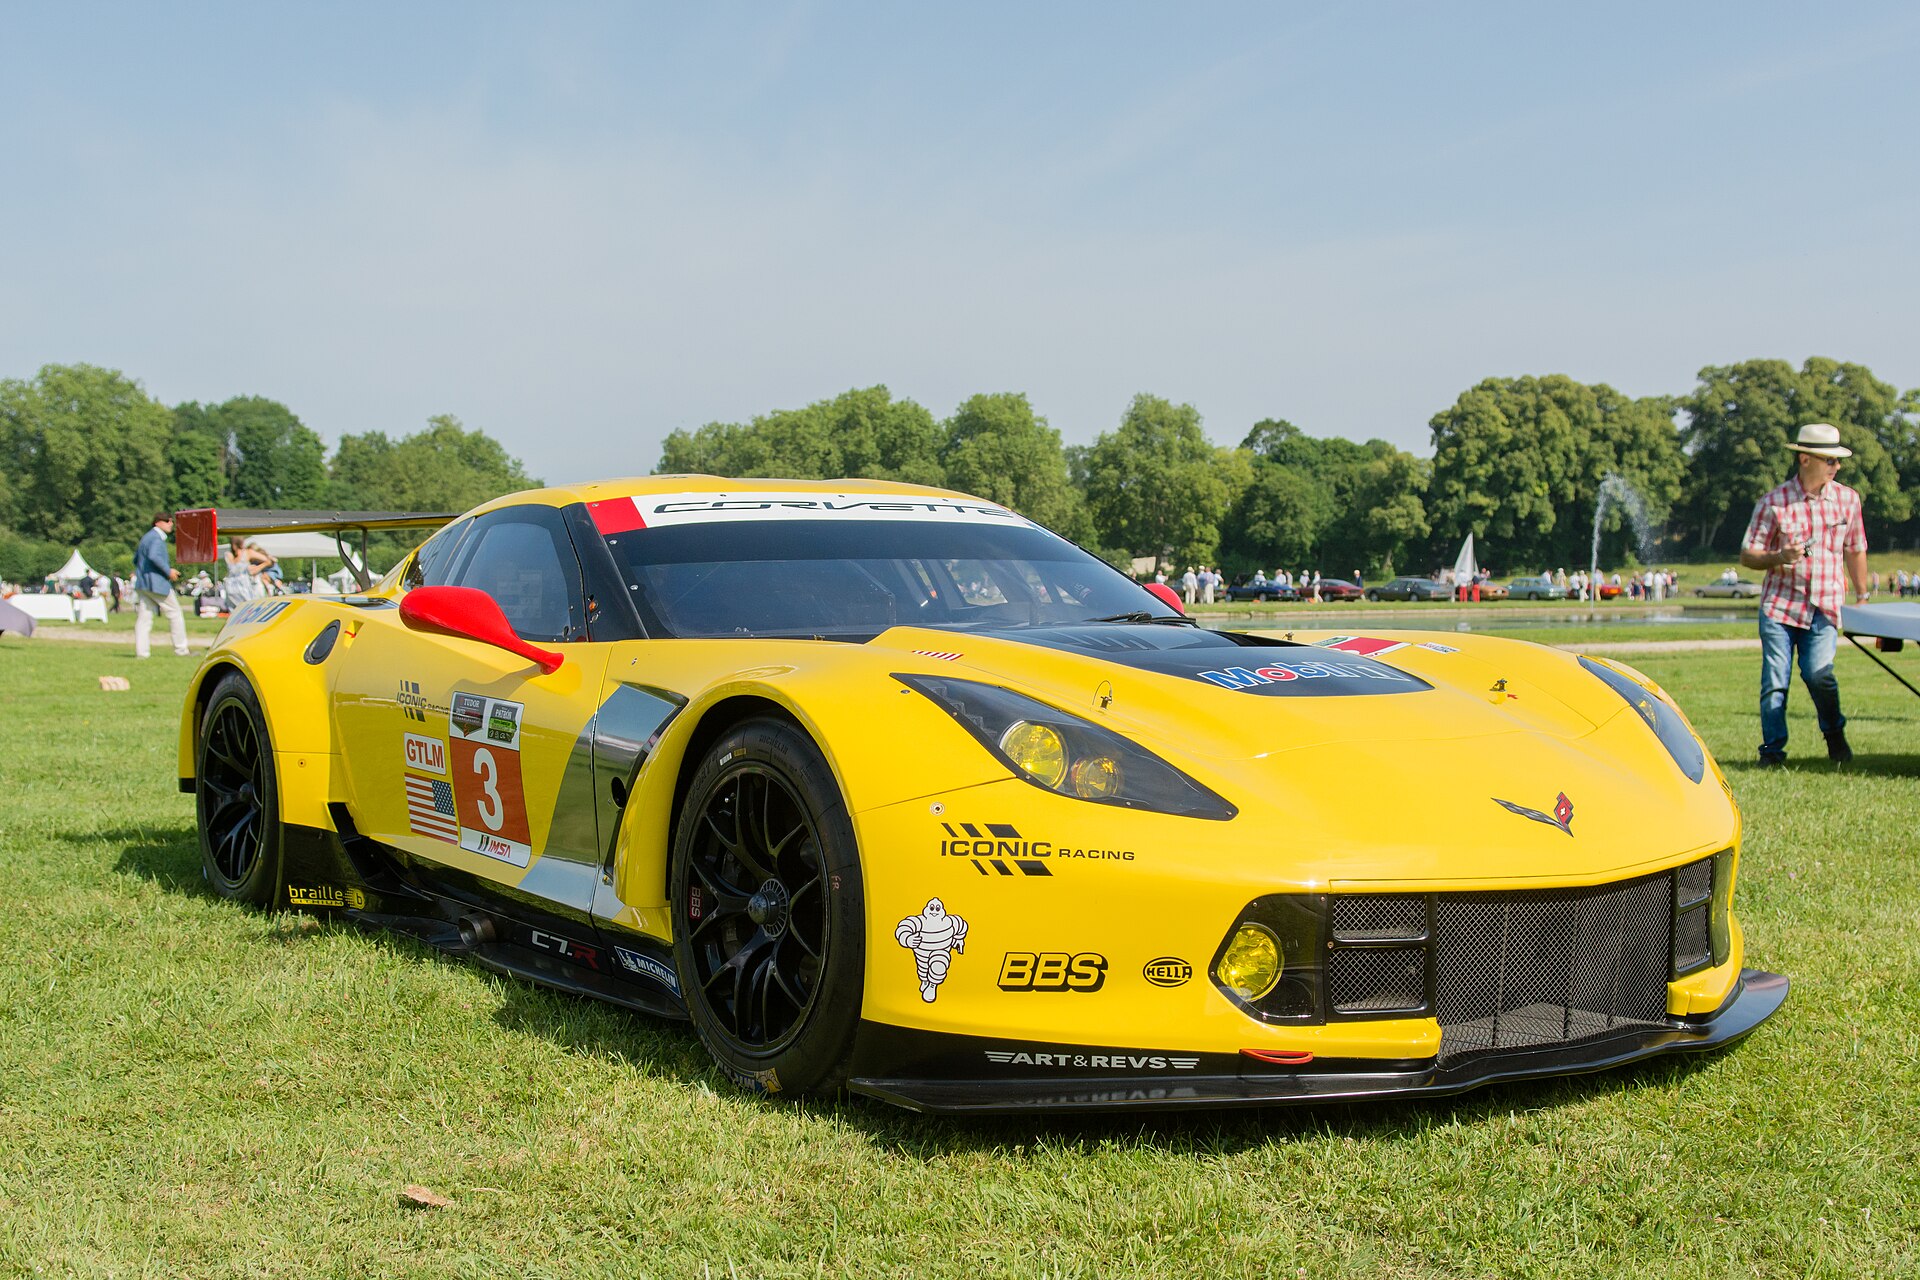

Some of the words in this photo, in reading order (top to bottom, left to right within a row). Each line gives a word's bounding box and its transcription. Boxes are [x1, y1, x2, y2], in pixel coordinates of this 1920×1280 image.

[654, 501, 1014, 519] CORVETTE
[1197, 661, 1360, 690] Mobil
[397, 692, 427, 709] ICONIC
[464, 698, 480, 708] TUDOR
[406, 738, 444, 769] GTLM
[473, 747, 504, 832] 3
[488, 839, 512, 858] IMSA
[941, 840, 1052, 858] ICONIC
[1058, 848, 1135, 861] RACING
[288, 884, 343, 899] braille
[690, 886, 701, 918] BBS
[636, 957, 676, 988] MICHELIN
[998, 952, 1108, 992] BBS
[1146, 965, 1193, 981] HELLA
[1010, 1052, 1168, 1069] ART&REVS
